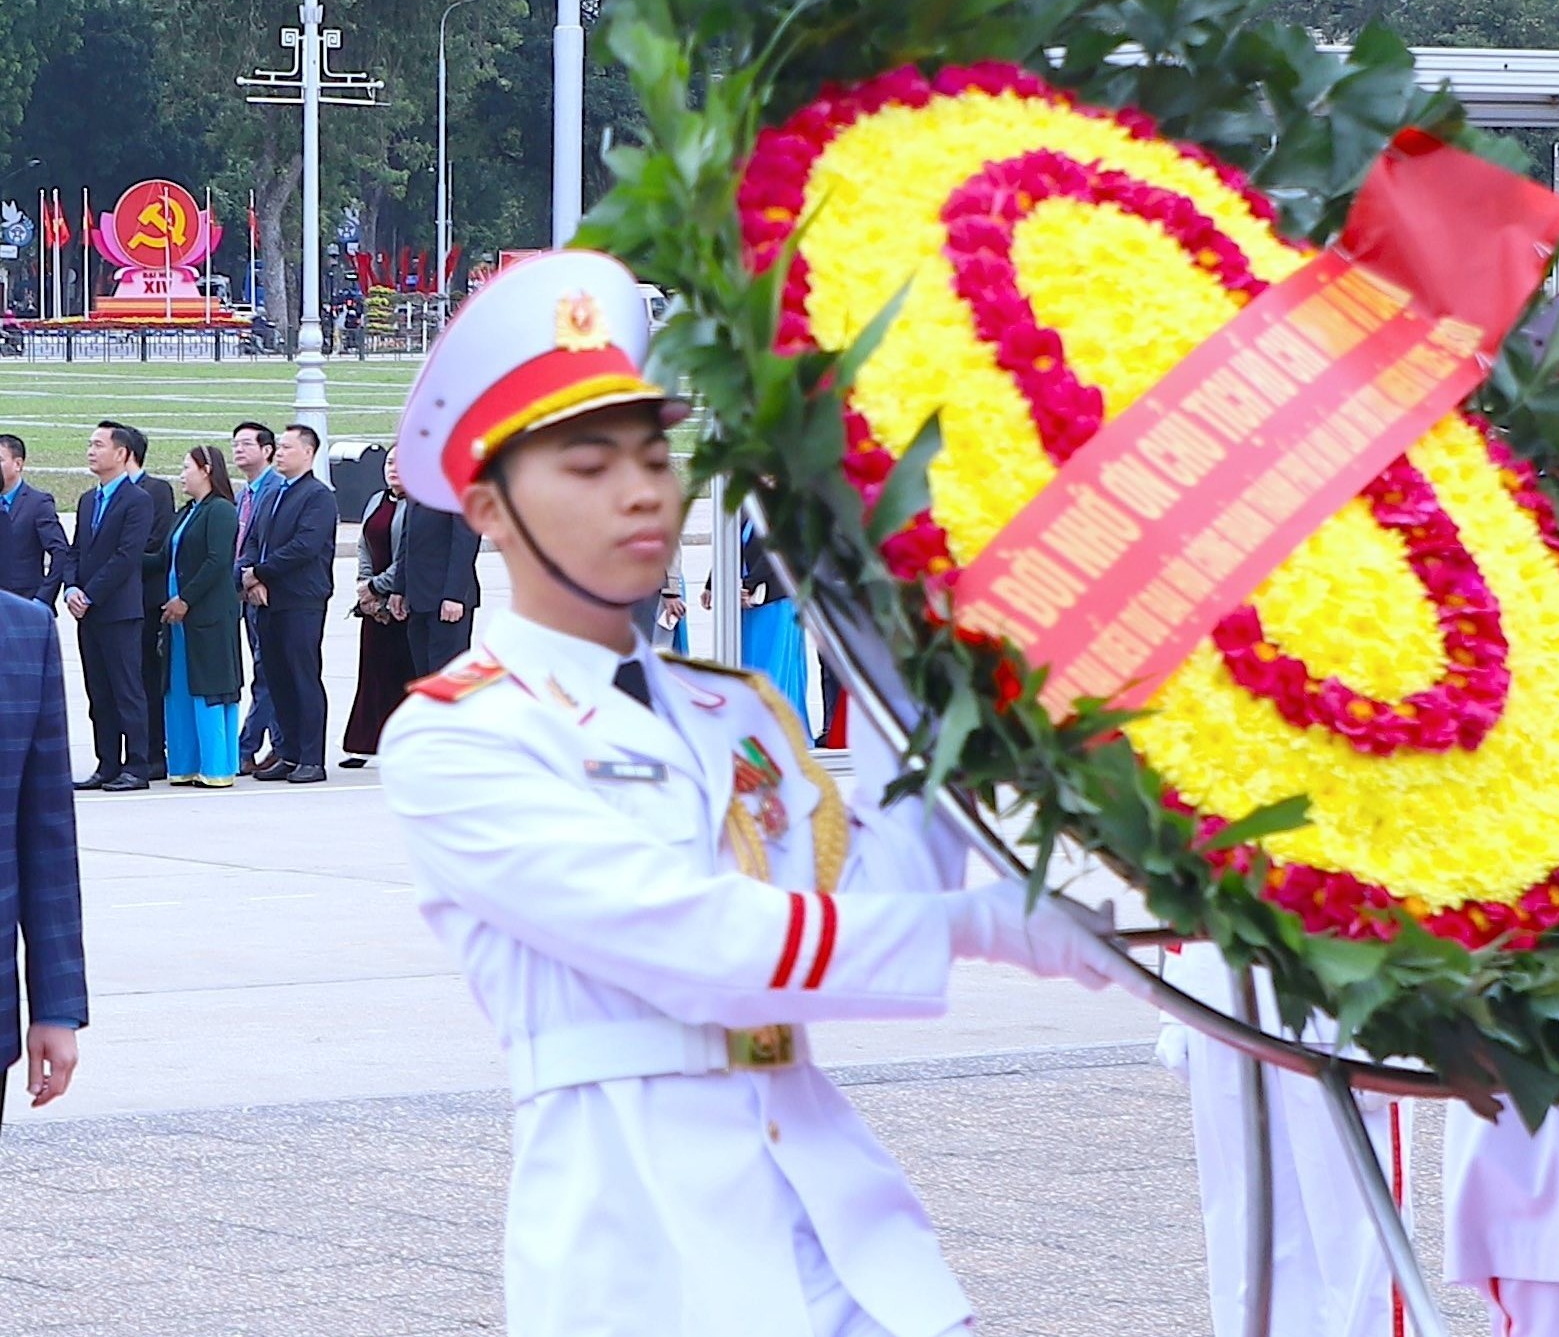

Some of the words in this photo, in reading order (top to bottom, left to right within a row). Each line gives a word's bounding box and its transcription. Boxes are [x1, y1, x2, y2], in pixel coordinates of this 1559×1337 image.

[144, 281, 172, 293] XIV
[1135, 396, 1228, 486] CHỦ
[1178, 364, 1274, 445] TỊCH
[1097, 448, 1181, 517] ƠN
[1038, 482, 1140, 577] NHỚ
[988, 545, 1086, 630] ĐỜI
